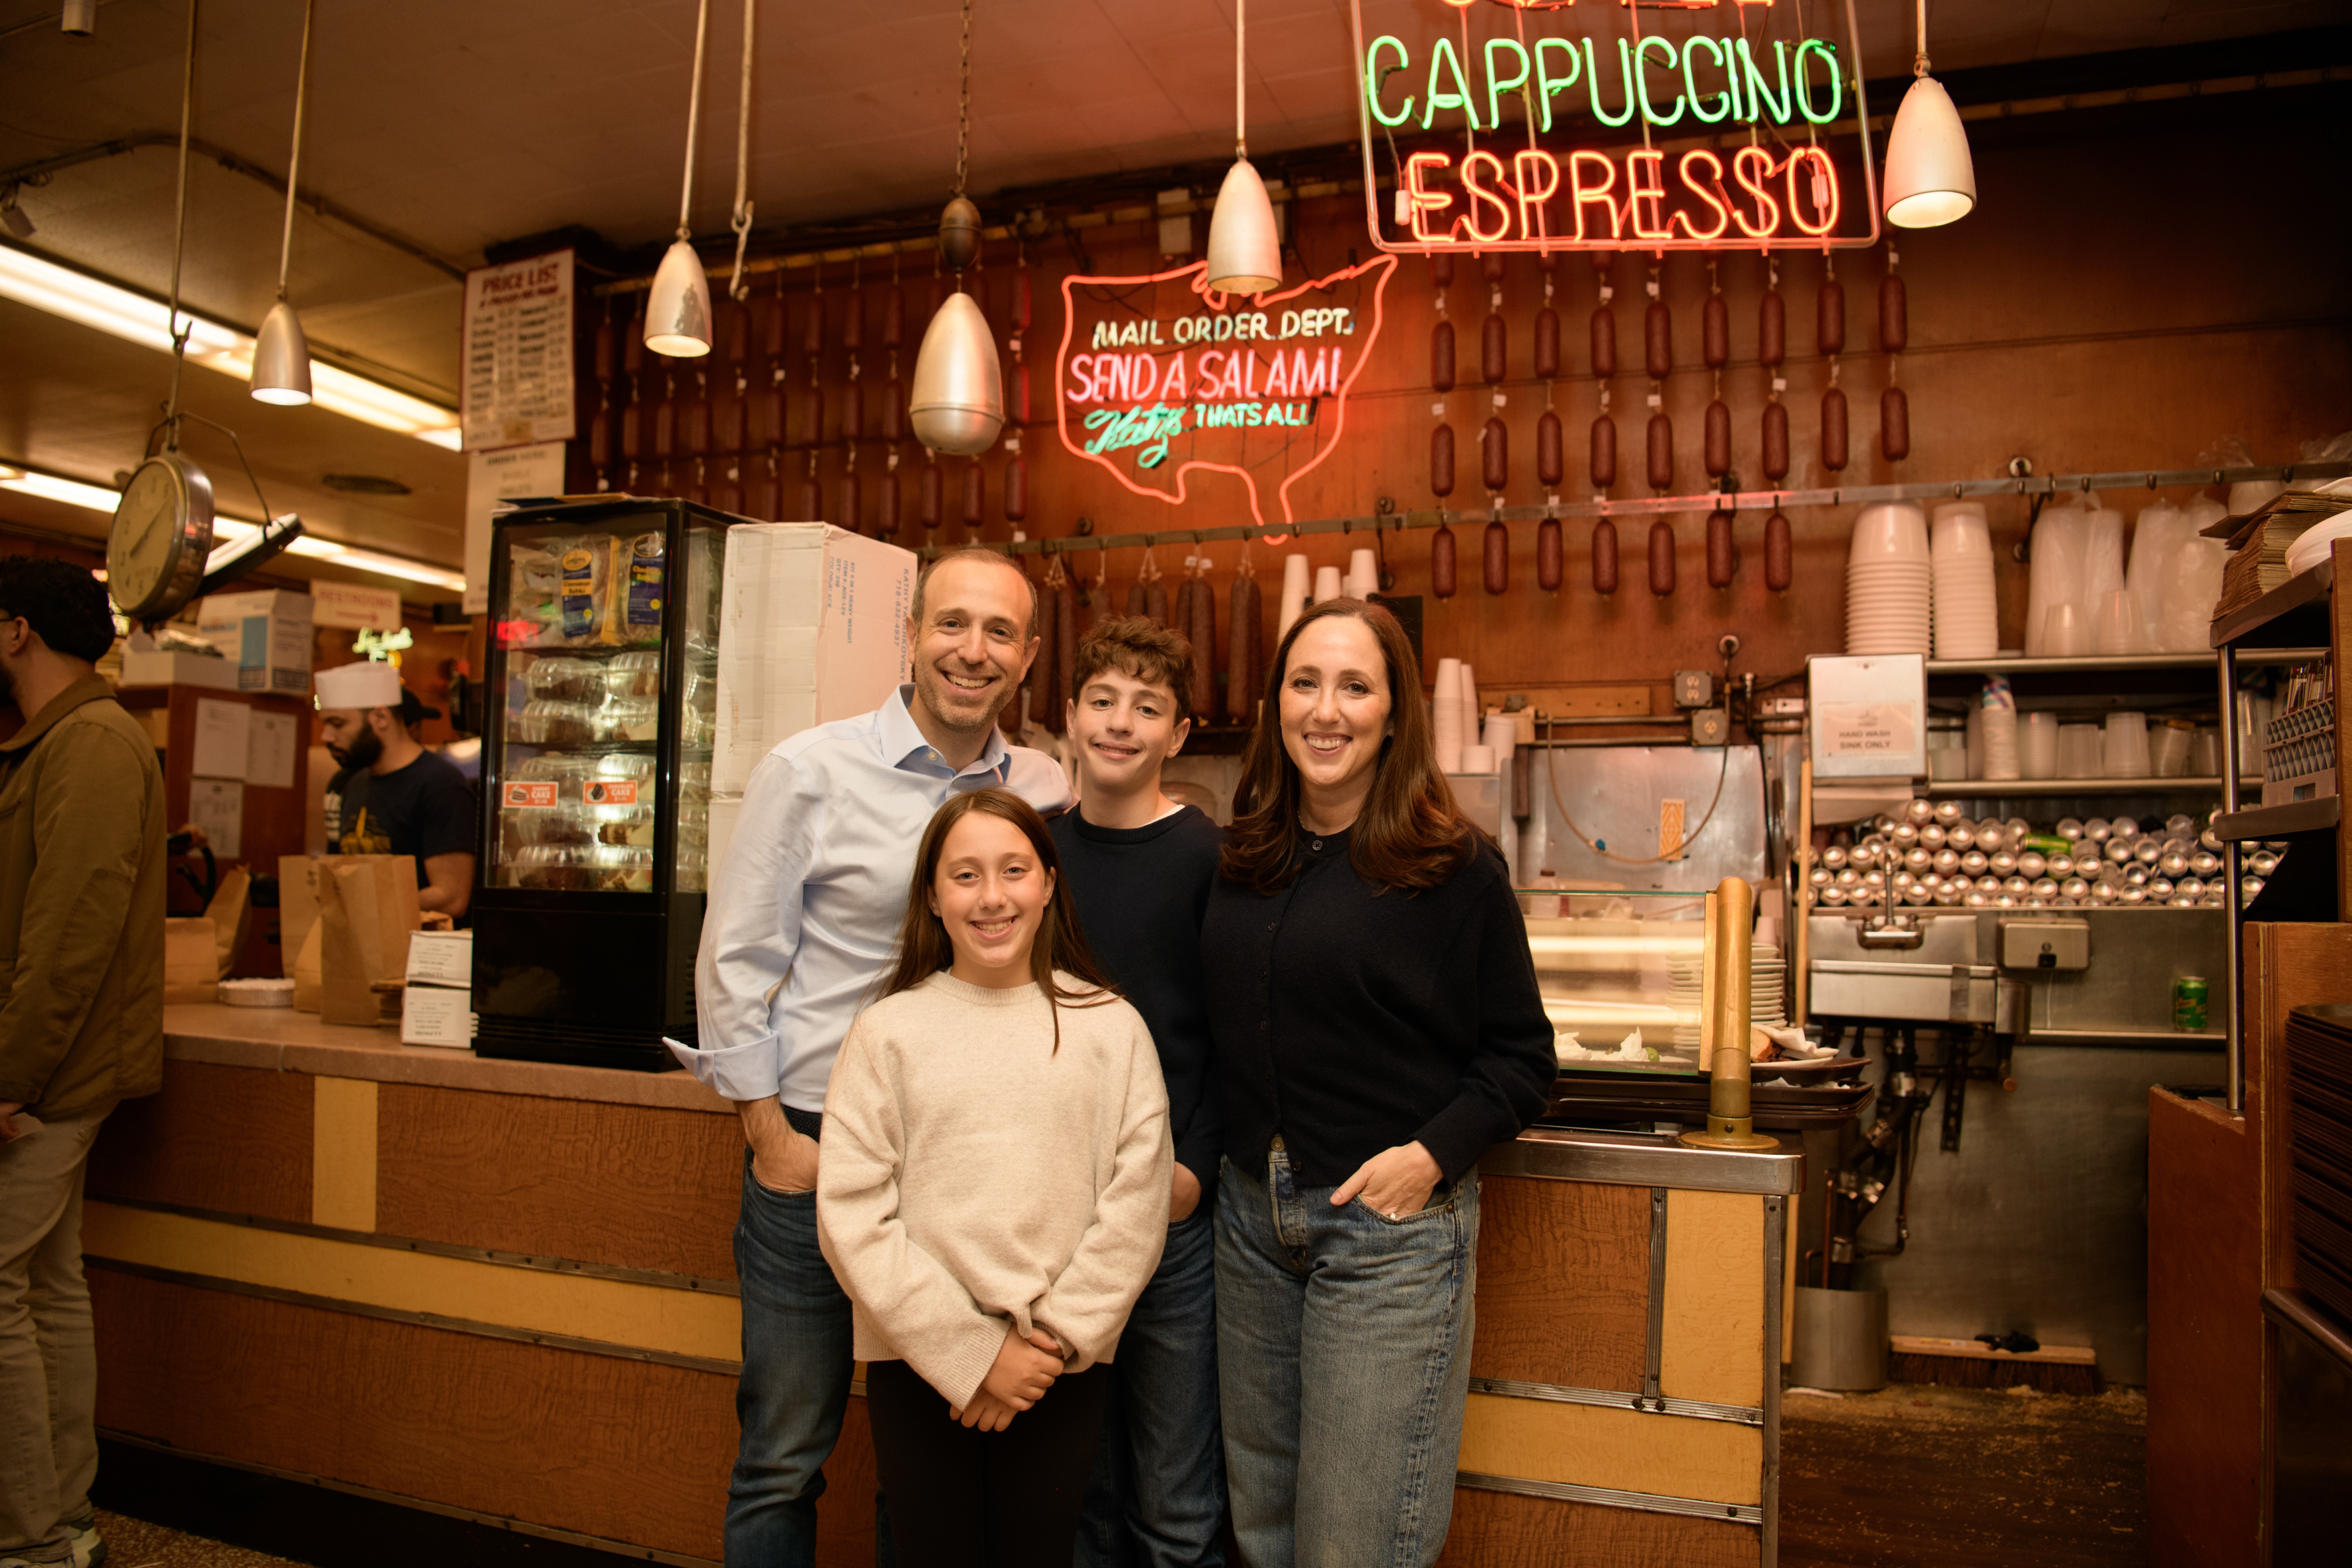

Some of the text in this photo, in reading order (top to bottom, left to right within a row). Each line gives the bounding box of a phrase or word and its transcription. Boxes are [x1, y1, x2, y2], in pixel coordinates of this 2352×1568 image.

[1366, 34, 1842, 133] CAPPUCCINO
[1408, 147, 1840, 242] ESPRESSO
[482, 264, 558, 295] PRICE LIST
[1092, 319, 1164, 350] MAIL
[1173, 311, 1268, 344] ORDER
[1066, 346, 1344, 403] SEND A SALAMI
[1865, 740, 1890, 749] ONLY
[531, 790, 551, 799] CAKE
